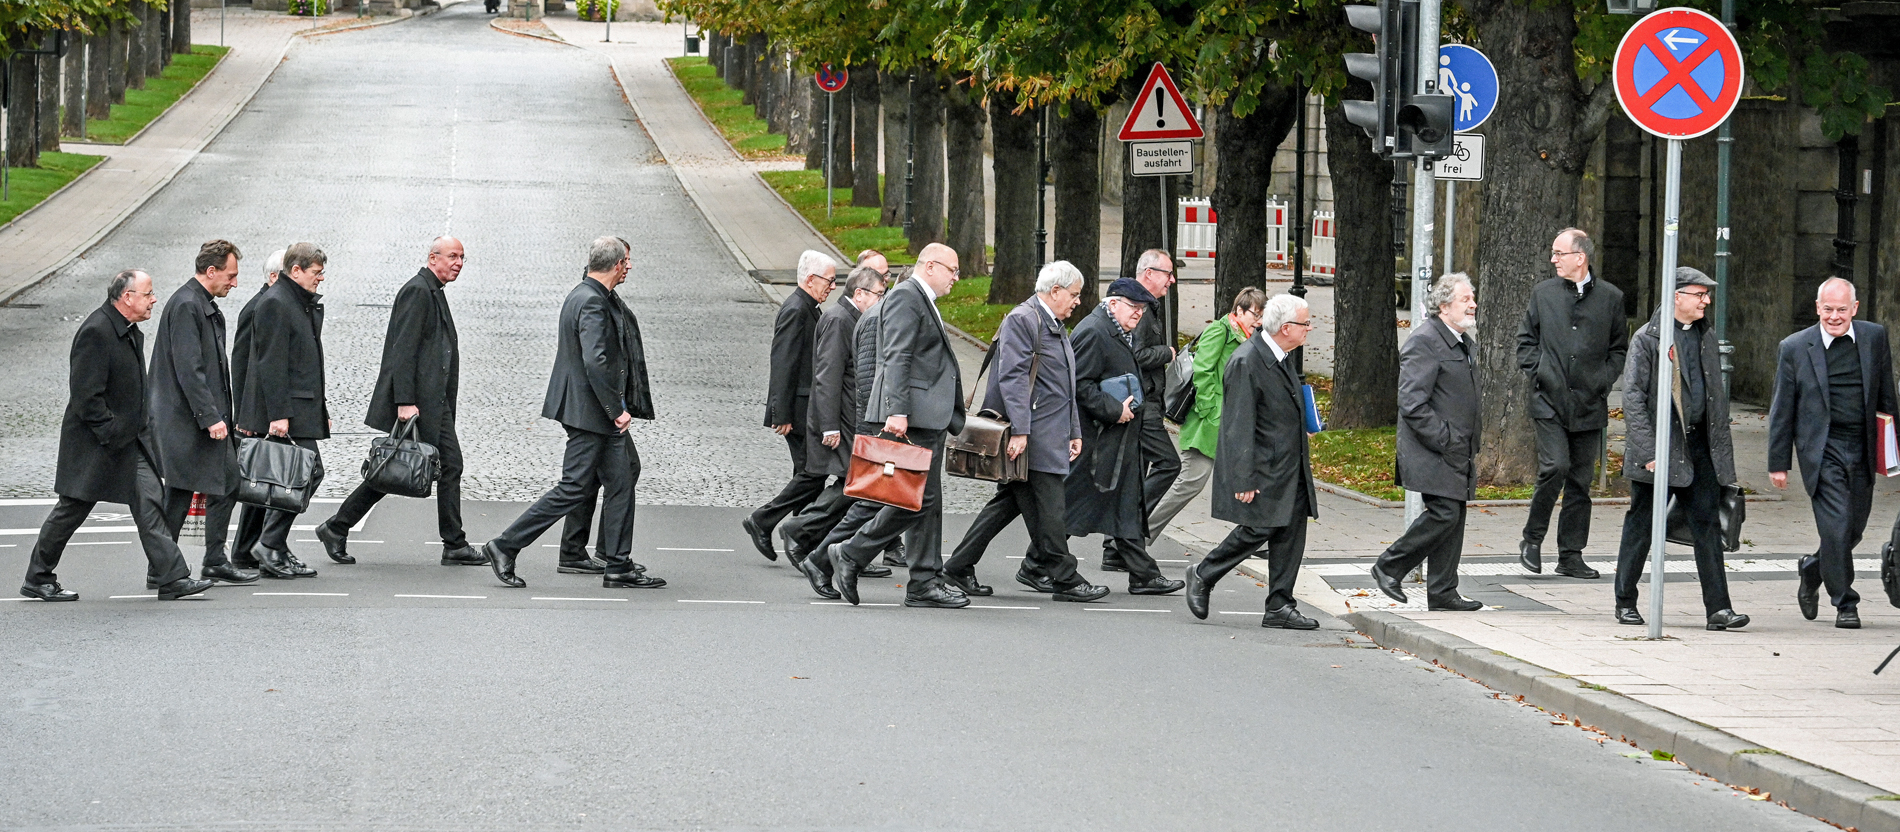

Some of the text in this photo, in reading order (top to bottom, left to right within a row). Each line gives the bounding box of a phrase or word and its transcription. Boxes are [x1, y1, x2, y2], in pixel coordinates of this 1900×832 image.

[1136, 148, 1189, 157] Baustellen-
[1144, 159, 1182, 167] ausfahrt
[1443, 163, 1462, 173] frei
